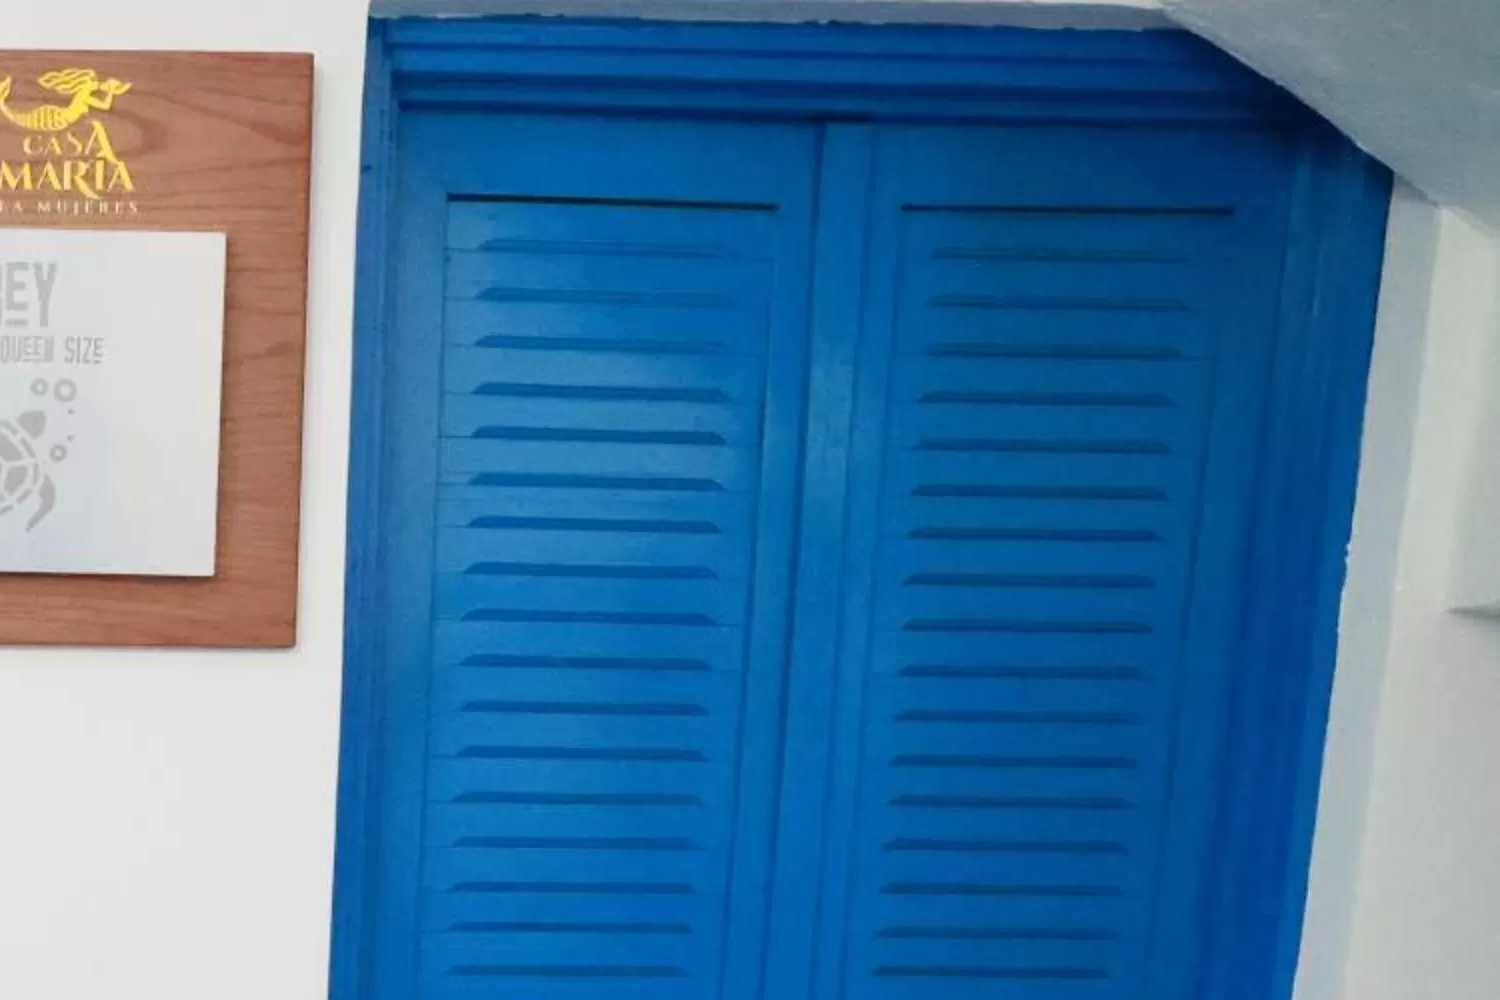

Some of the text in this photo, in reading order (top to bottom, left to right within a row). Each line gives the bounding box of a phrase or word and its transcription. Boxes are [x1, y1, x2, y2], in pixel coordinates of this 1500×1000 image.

[23, 120, 120, 166] CASA
[0, 335, 55, 363] QUEEN
[64, 337, 105, 364] SIZE
